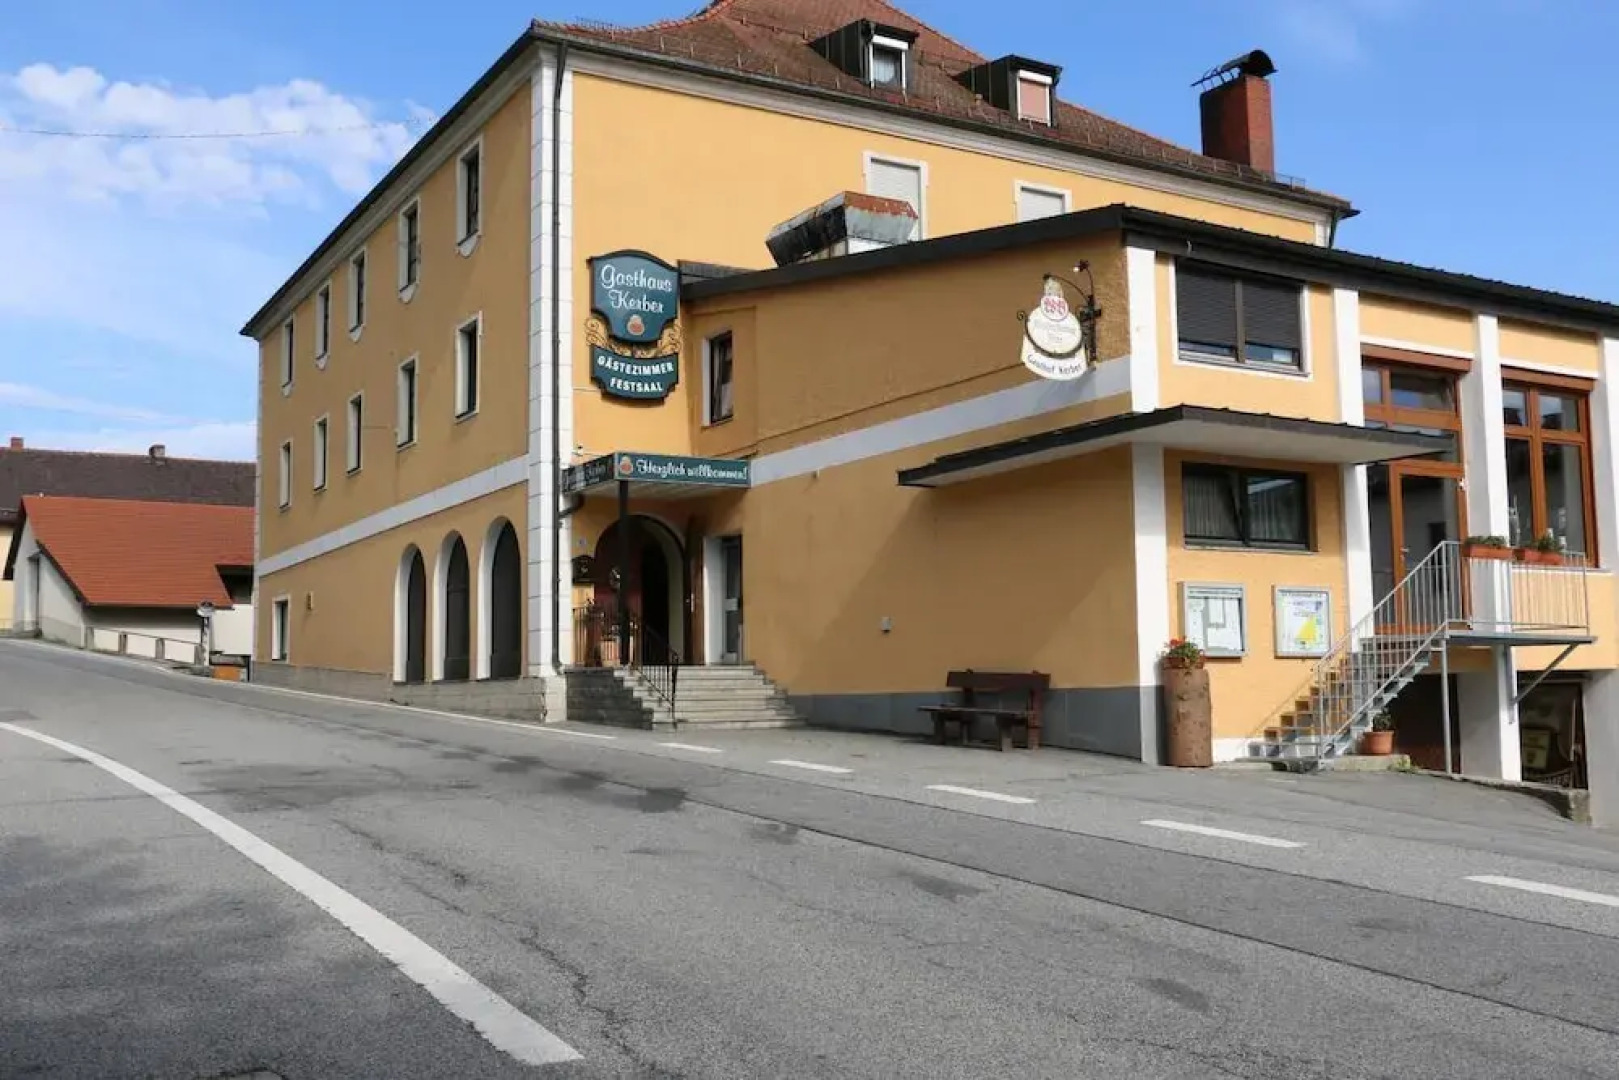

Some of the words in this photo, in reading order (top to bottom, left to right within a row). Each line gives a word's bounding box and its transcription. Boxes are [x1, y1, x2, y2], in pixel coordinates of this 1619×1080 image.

[601, 264, 672, 292] Gasthaus
[608, 289, 664, 313] Kerber
[597, 355, 674, 375] GÄSTEZIMMER
[610, 377, 663, 393] FESTSAAL
[636, 459, 686, 478] Herzlich
[687, 464, 748, 480] willkommen!
